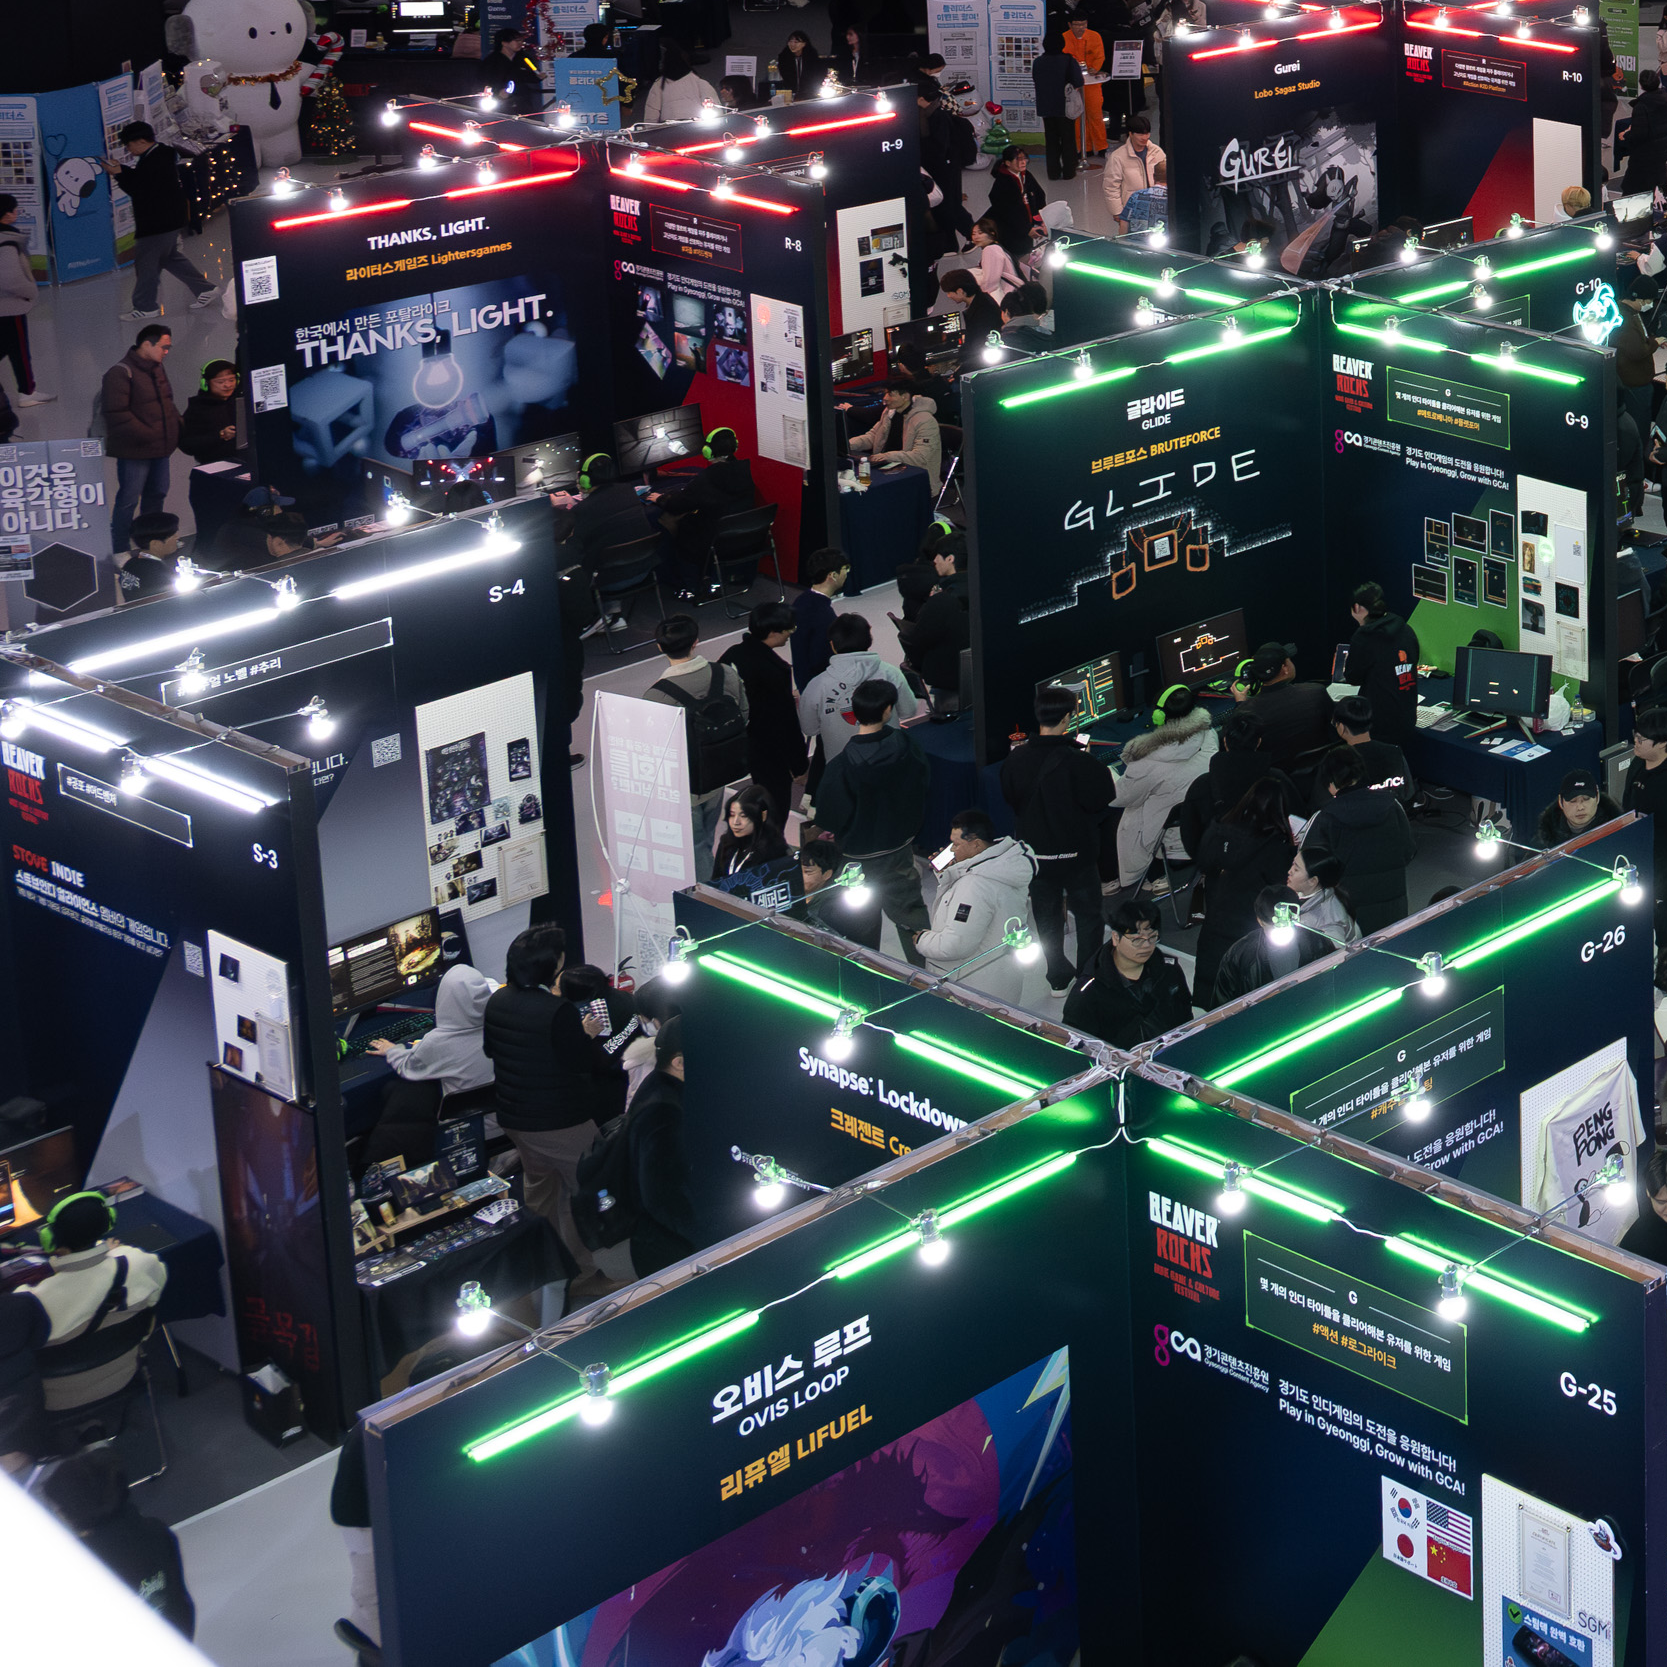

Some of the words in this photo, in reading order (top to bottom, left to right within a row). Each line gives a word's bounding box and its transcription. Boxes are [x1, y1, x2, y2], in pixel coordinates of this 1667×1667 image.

[1274, 60, 1300, 75] Gurei
[1562, 70, 1583, 83] R-10
[1255, 88, 1273, 99] Lobo
[1275, 84, 1296, 96] Sagaz
[1298, 79, 1321, 91] Studio
[882, 137, 903, 152] R-9
[368, 227, 437, 250] THANKS,
[440, 216, 490, 237] LIGHT.
[785, 237, 801, 252] R-8
[346, 255, 428, 281] 라이터스게임즈
[431, 241, 512, 265] Lightersgames
[295, 321, 350, 343] 한국에서
[355, 313, 381, 331] 만든
[385, 300, 450, 324] 포탈라이크
[296, 318, 441, 368] THANKS,
[453, 294, 553, 337] LIGHT.
[1126, 388, 1185, 420] 글라이드
[1141, 413, 1171, 431] GLIDE
[1565, 411, 1589, 429] G-9
[1091, 440, 1147, 475] 브루트포스
[1150, 425, 1221, 459] BRUTEFORCE
[0, 461, 78, 492] 이것은
[4, 507, 88, 535] 아니다.
[488, 578, 525, 603] S-4
[13, 844, 49, 872] STOVE
[51, 861, 84, 888] INDIE
[253, 844, 278, 869] S-3
[1580, 925, 1626, 963] G-26
[800, 1047, 874, 1096] Synapse:
[1149, 1191, 1220, 1248] BEAVER
[1157, 1227, 1213, 1279] ROCKS
[1260, 1277, 1269, 1292] 몇
[1270, 1282, 1287, 1298] 개의
[1289, 1290, 1305, 1307] 인디
[1307, 1297, 1340, 1323] 타이틀을
[1342, 1313, 1384, 1342] 클리어해본
[1386, 1330, 1412, 1354] 유저를
[1414, 1343, 1432, 1363] 위한
[1434, 1352, 1451, 1372] 게임
[711, 1354, 805, 1426] 오비스
[813, 1315, 872, 1369] 루프
[738, 1394, 789, 1436] OVIS
[794, 1366, 850, 1410] LOOP
[1559, 1371, 1617, 1416] G-25
[1279, 1379, 1309, 1405] 경기도
[1312, 1394, 1362, 1428] 인디게임의
[1366, 1416, 1397, 1445] 도전을
[1399, 1434, 1456, 1472] 응원합니다!
[720, 1447, 791, 1503] 리퓨엘
[797, 1405, 873, 1462] LIFUEL
[1279, 1398, 1302, 1421] Play
[1304, 1410, 1315, 1423] in
[1317, 1415, 1373, 1456] Gyeonggi,
[1375, 1443, 1405, 1468] Grow
[1407, 1458, 1432, 1481] with
[1435, 1471, 1465, 1495] GCA!
